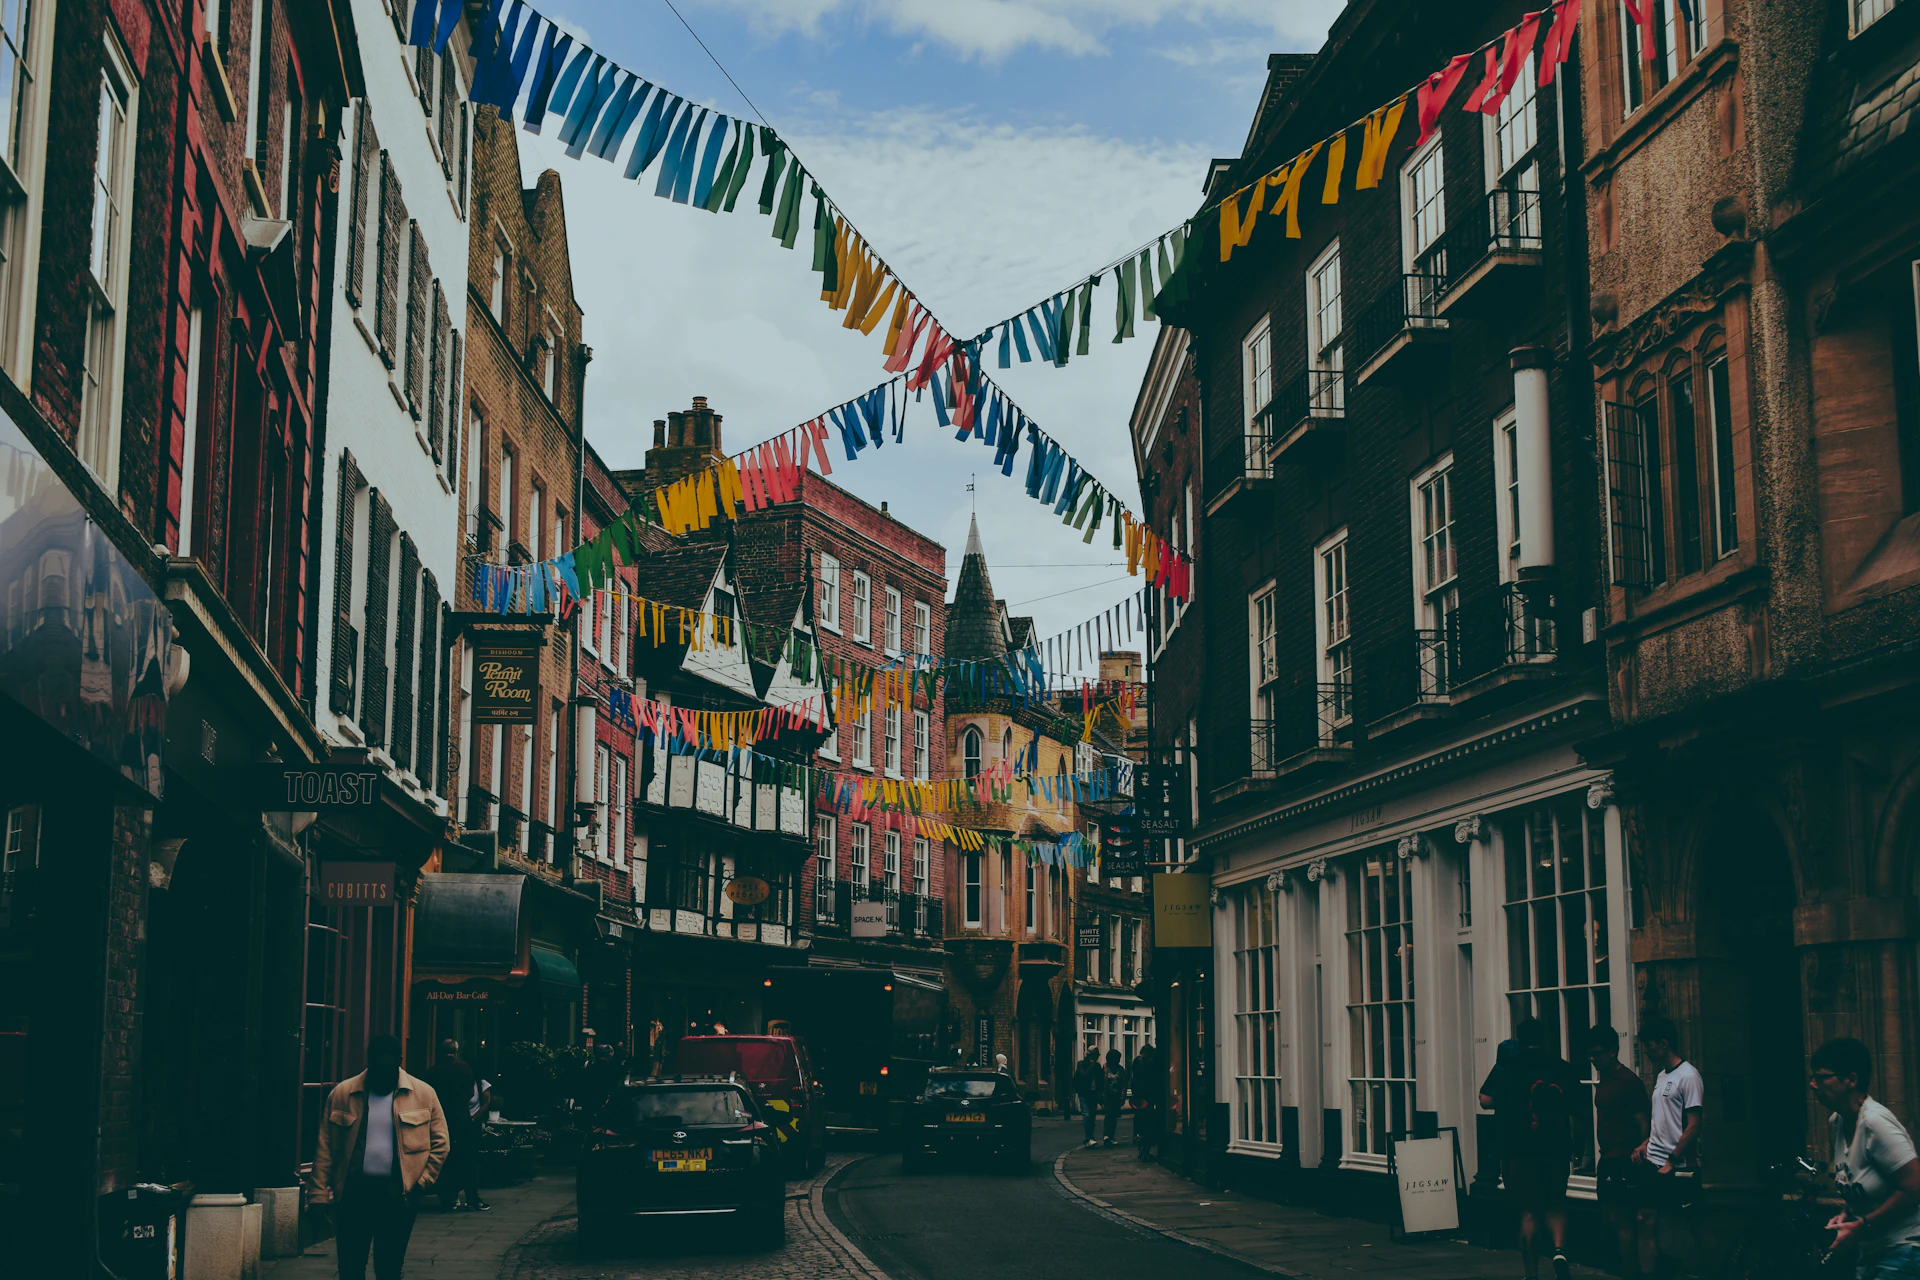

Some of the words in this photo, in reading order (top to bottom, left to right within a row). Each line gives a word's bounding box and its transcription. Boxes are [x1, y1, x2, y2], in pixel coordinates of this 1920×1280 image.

[479, 662, 523, 684] Permit
[485, 680, 531, 703] Room
[284, 771, 377, 805] TOAST
[1141, 819, 1180, 829] SEASALT
[1351, 805, 1383, 833] JIGSAW
[1106, 861, 1139, 870] SEASALT
[328, 882, 387, 899] CUBITTS
[1164, 904, 1202, 912] JIGSAW
[1079, 937, 1100, 945] STUFF
[981, 1019, 989, 1042] WHITE
[980, 1043, 988, 1067] STUFF
[687, 1147, 710, 1160] NKA
[1405, 1178, 1449, 1191] JIGSAW
